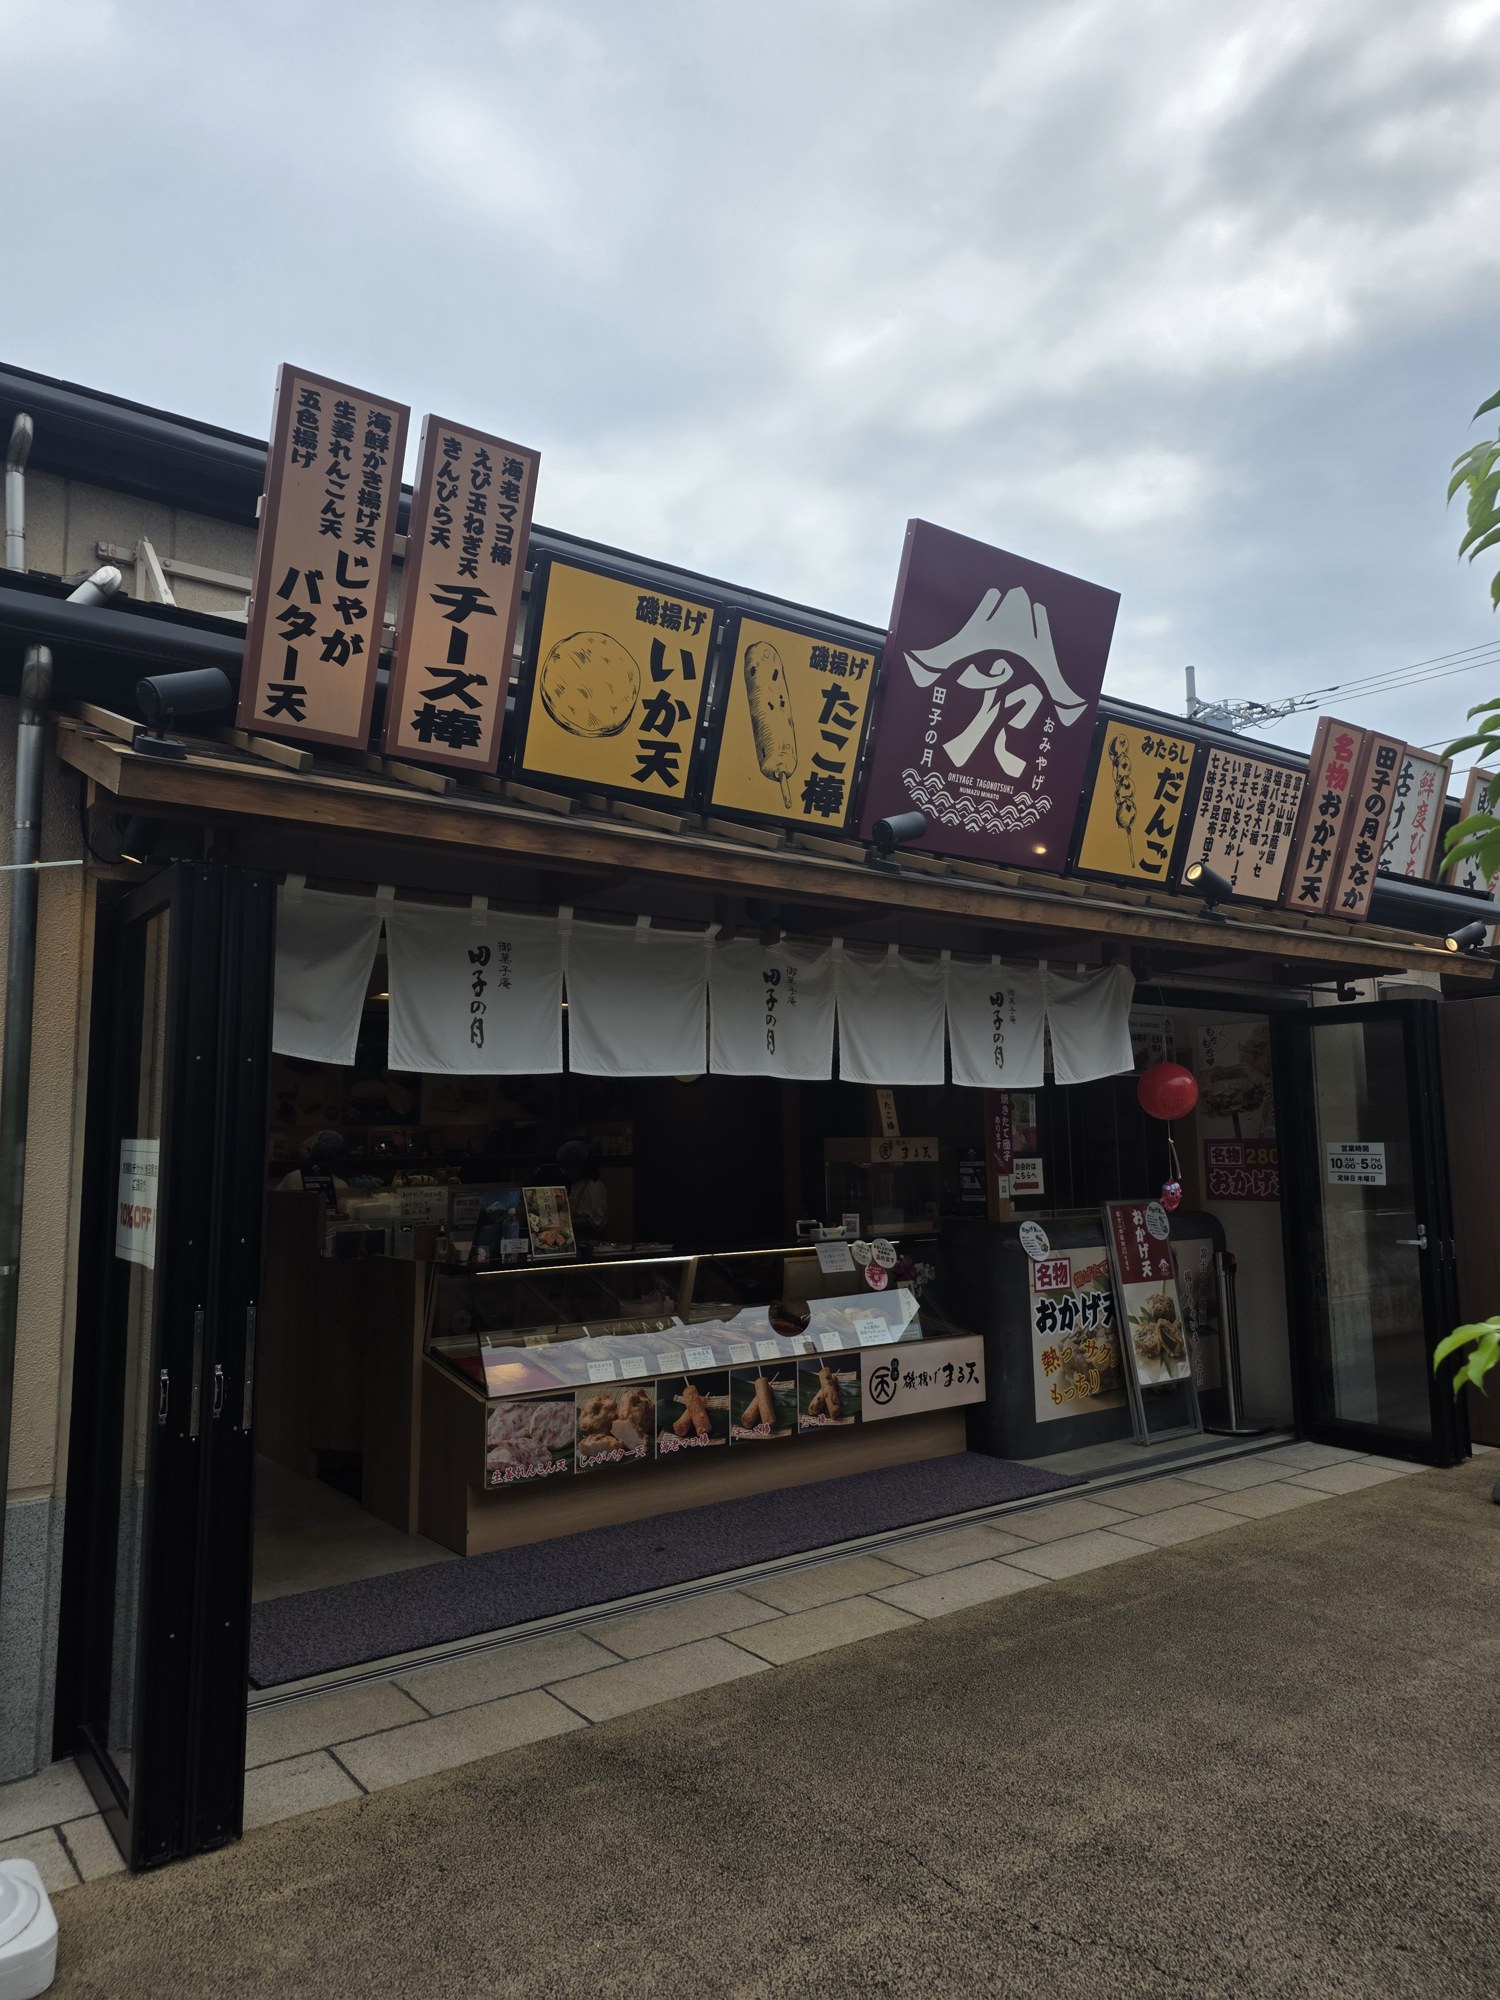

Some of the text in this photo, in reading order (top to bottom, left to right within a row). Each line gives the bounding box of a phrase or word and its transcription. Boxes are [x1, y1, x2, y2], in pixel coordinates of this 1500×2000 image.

[291, 387, 322, 469] 五色揚げ
[318, 400, 357, 540] 生姜れんこん天
[352, 409, 392, 549] 海鮮かき揚げ天
[429, 436, 463, 550] きんぴら天
[457, 447, 493, 580] えび玉ねぎ天
[490, 456, 524, 566] 海老マヨ棒
[319, 549, 371, 667] じゃが
[635, 595, 707, 637] 磯揚げ
[262, 567, 324, 723] バター天
[410, 583, 498, 750] チーズ棒
[809, 645, 869, 681] 磯揚げ
[631, 637, 697, 789] いか天
[920, 686, 947, 768] 田子の月
[800, 682, 860, 818] たこ棒
[947, 772, 1014, 795] OMIYAGE TAGONOTSUKI
[1031, 716, 1055, 792] おみやげ
[1141, 735, 1190, 765] みたらし
[1199, 753, 1220, 819] 七味団子
[959, 786, 1000, 801] NUMAZU MINATO
[1138, 766, 1184, 874] だんご
[1218, 759, 1242, 839] いそべ団子
[1224, 761, 1253, 857] 富士山もなか
[1249, 767, 1274, 847] 深海塩大福
[1282, 775, 1303, 838] 富士山頂
[1342, 745, 1398, 910] 田子の月もなか
[467, 945, 491, 1049] 田子の月
[762, 968, 781, 1056] 田子の月
[989, 991, 1005, 1070] 田子の月
[1000, 1092, 1012, 1163] 焼きたて団子
[1211, 1147, 1241, 1163] 名物
[1341, 1145, 1369, 1153] 営業時間
[1015, 1162, 1037, 1171] お会計は
[1015, 1171, 1037, 1180] こちらへ
[1036, 1263, 1069, 1288] 名物
[1132, 1208, 1153, 1278] おかげ天
[1041, 1346, 1073, 1377] 熱っ
[1051, 1369, 1101, 1405] もっちり
[578, 1445, 646, 1468] じゃがバター天
[659, 1433, 710, 1454] 海老マヨ棒
[733, 1422, 773, 1440] チーズ棒
[799, 1414, 828, 1429] たこ棒
[490, 1459, 567, 1484] 生姜れんこん天
